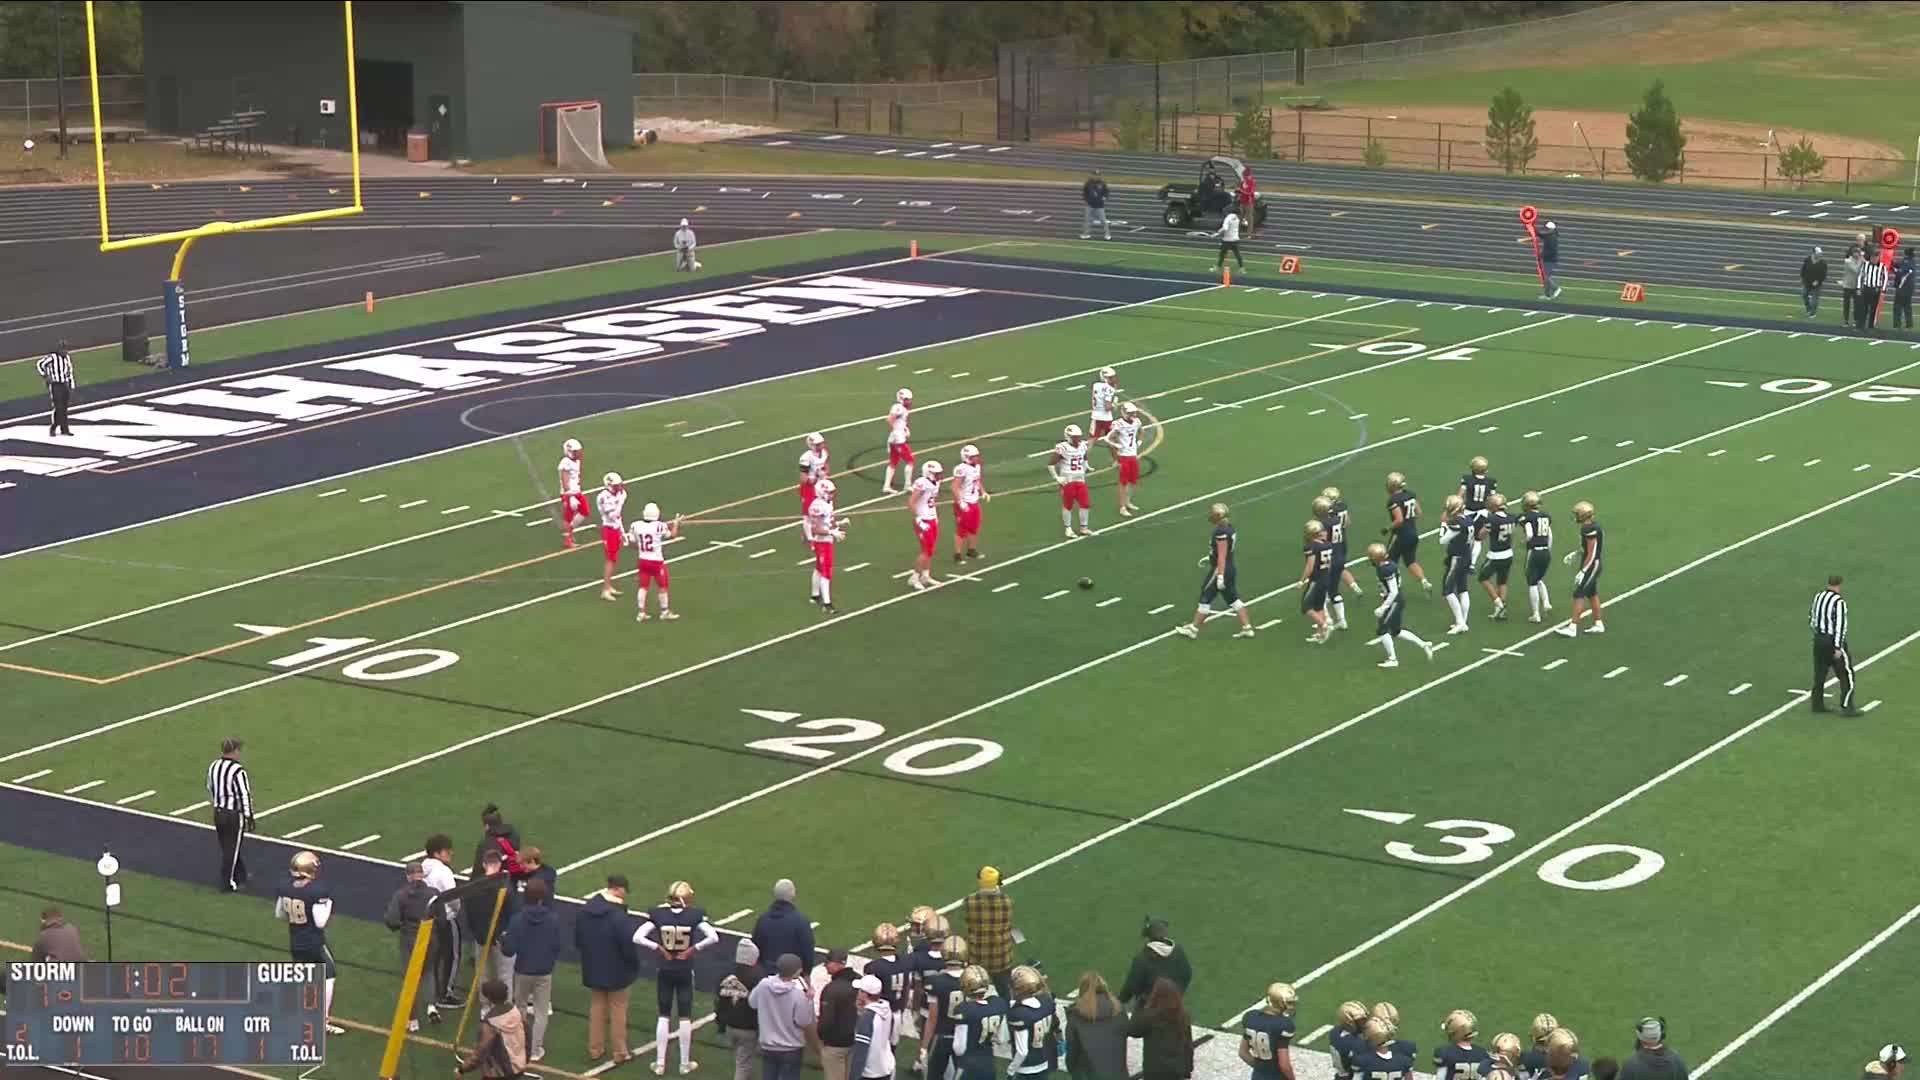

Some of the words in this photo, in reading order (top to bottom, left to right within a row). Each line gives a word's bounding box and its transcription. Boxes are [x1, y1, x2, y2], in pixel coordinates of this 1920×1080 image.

[1282, 258, 1295, 272] G
[1473, 484, 1486, 502] 11
[1536, 517, 1550, 537] 18
[638, 532, 654, 553] 12
[267, 636, 461, 681] 10
[743, 717, 1005, 777] 20
[1384, 818, 1666, 891] 30
